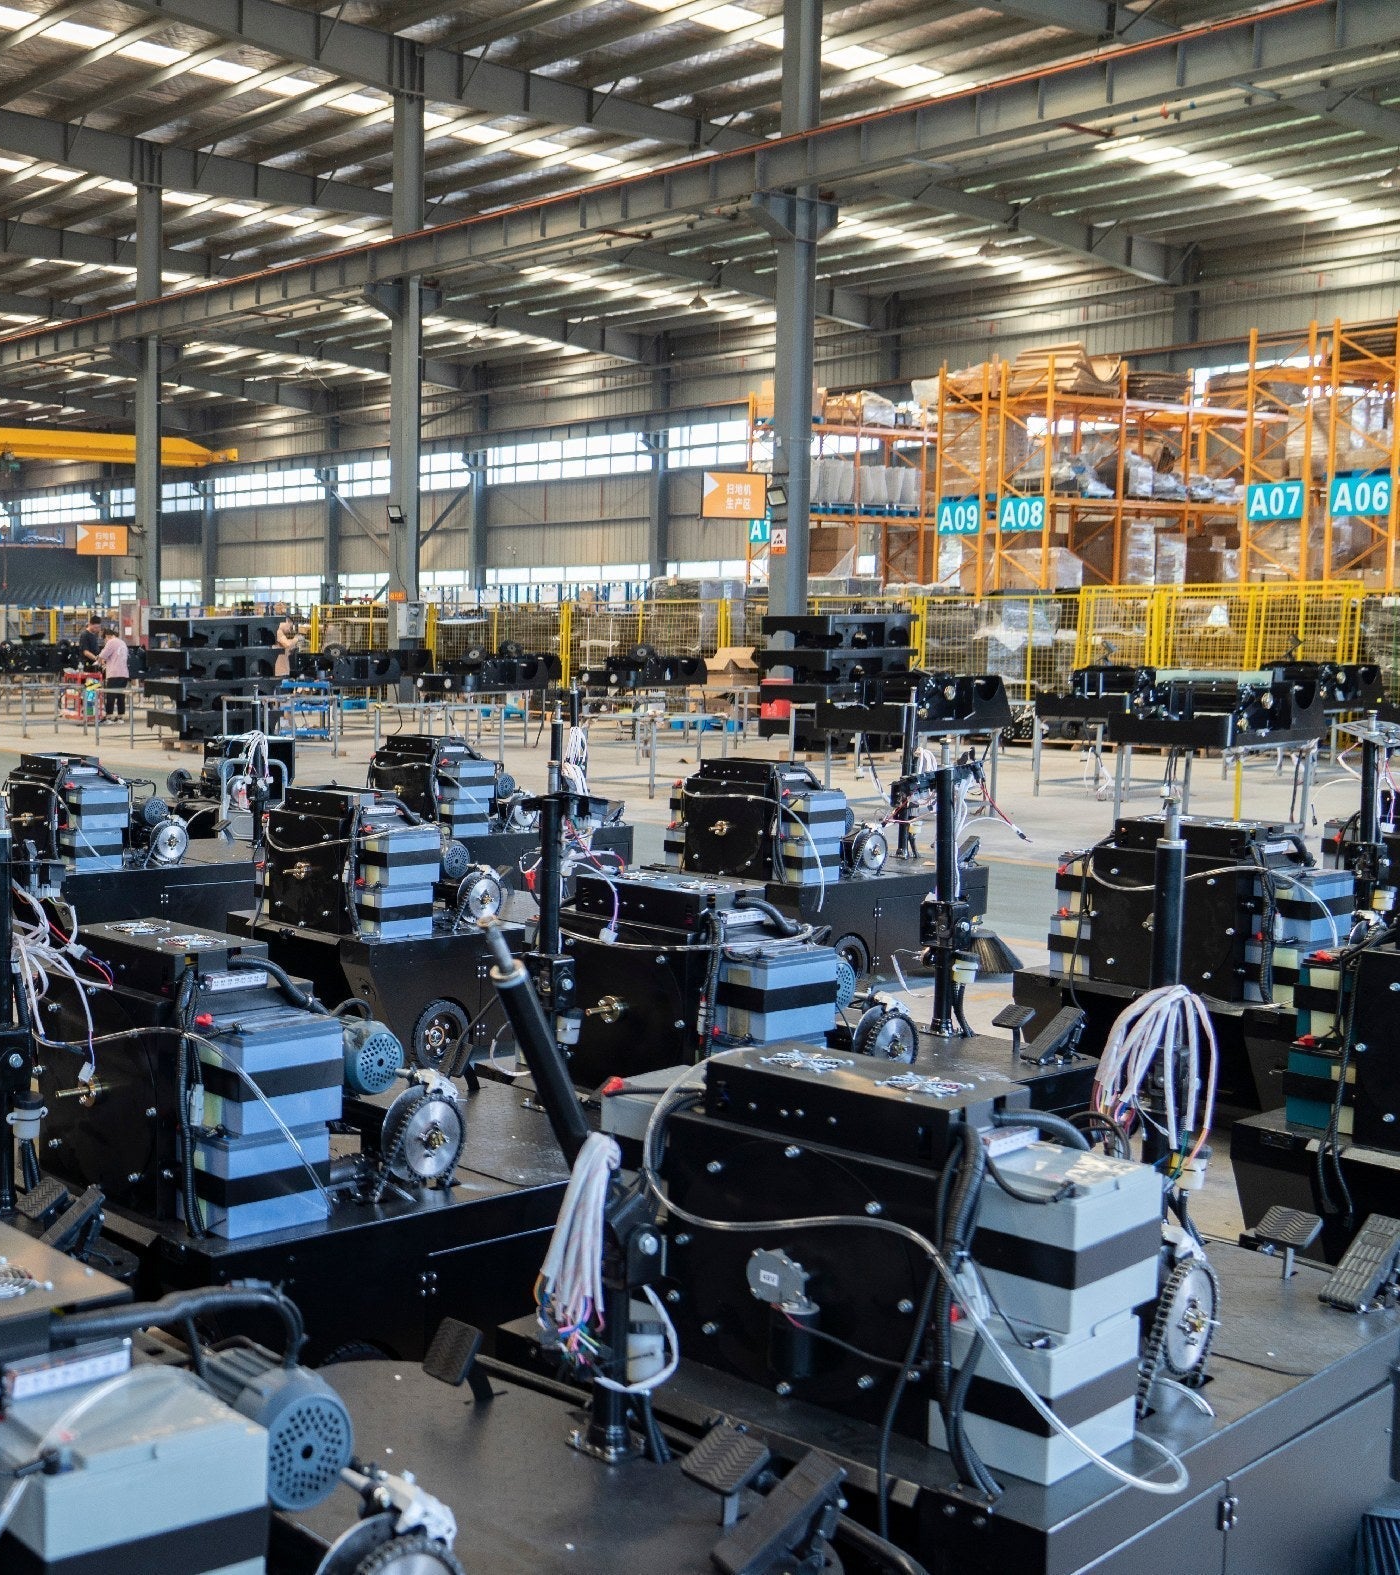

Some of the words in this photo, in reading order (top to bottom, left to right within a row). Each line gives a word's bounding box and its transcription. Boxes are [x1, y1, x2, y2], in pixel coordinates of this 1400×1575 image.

[726, 483, 751, 496] 扫地机
[1249, 486, 1301, 517] A07
[1332, 480, 1389, 513] A06
[725, 497, 751, 510] 生产区
[1000, 501, 1043, 528] A08
[750, 519, 771, 541] A1
[939, 505, 978, 531] A09
